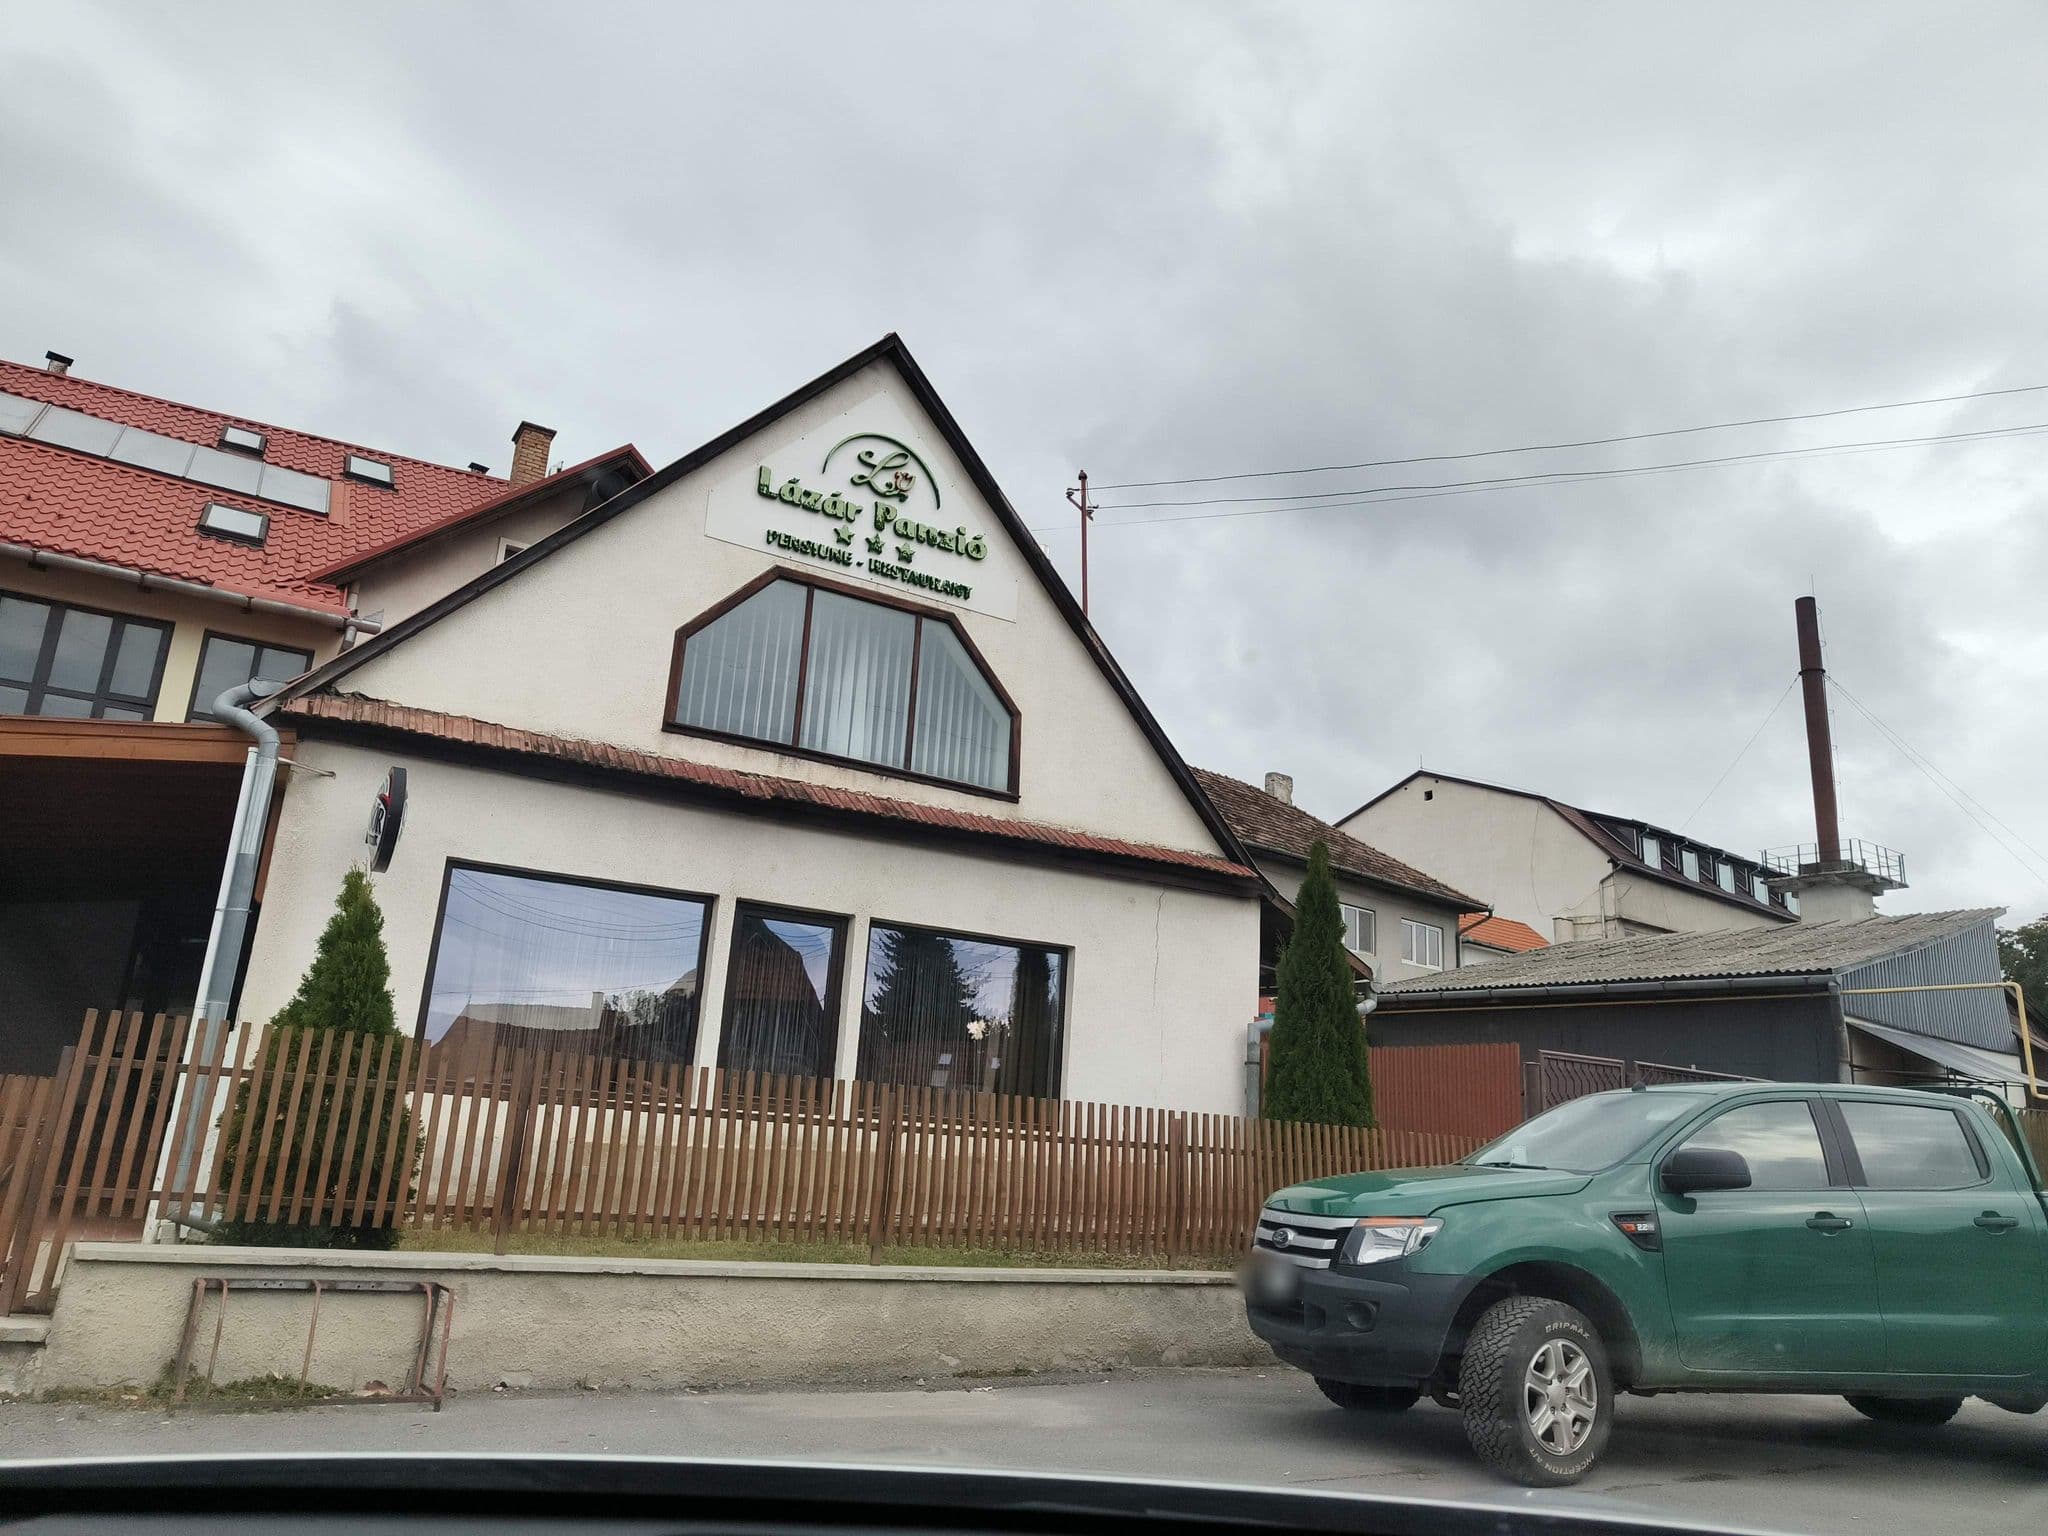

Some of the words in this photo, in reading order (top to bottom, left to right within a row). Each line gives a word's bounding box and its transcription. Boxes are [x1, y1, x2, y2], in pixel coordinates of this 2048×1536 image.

[758, 465, 863, 522] Lázár
[874, 500, 988, 560] Panzió
[766, 529, 853, 567] PENSIUNE
[868, 558, 973, 600] RESTAURANT
[1545, 1322, 1590, 1340] GRIPMAX
[1544, 1451, 1595, 1475] INCEPTION
